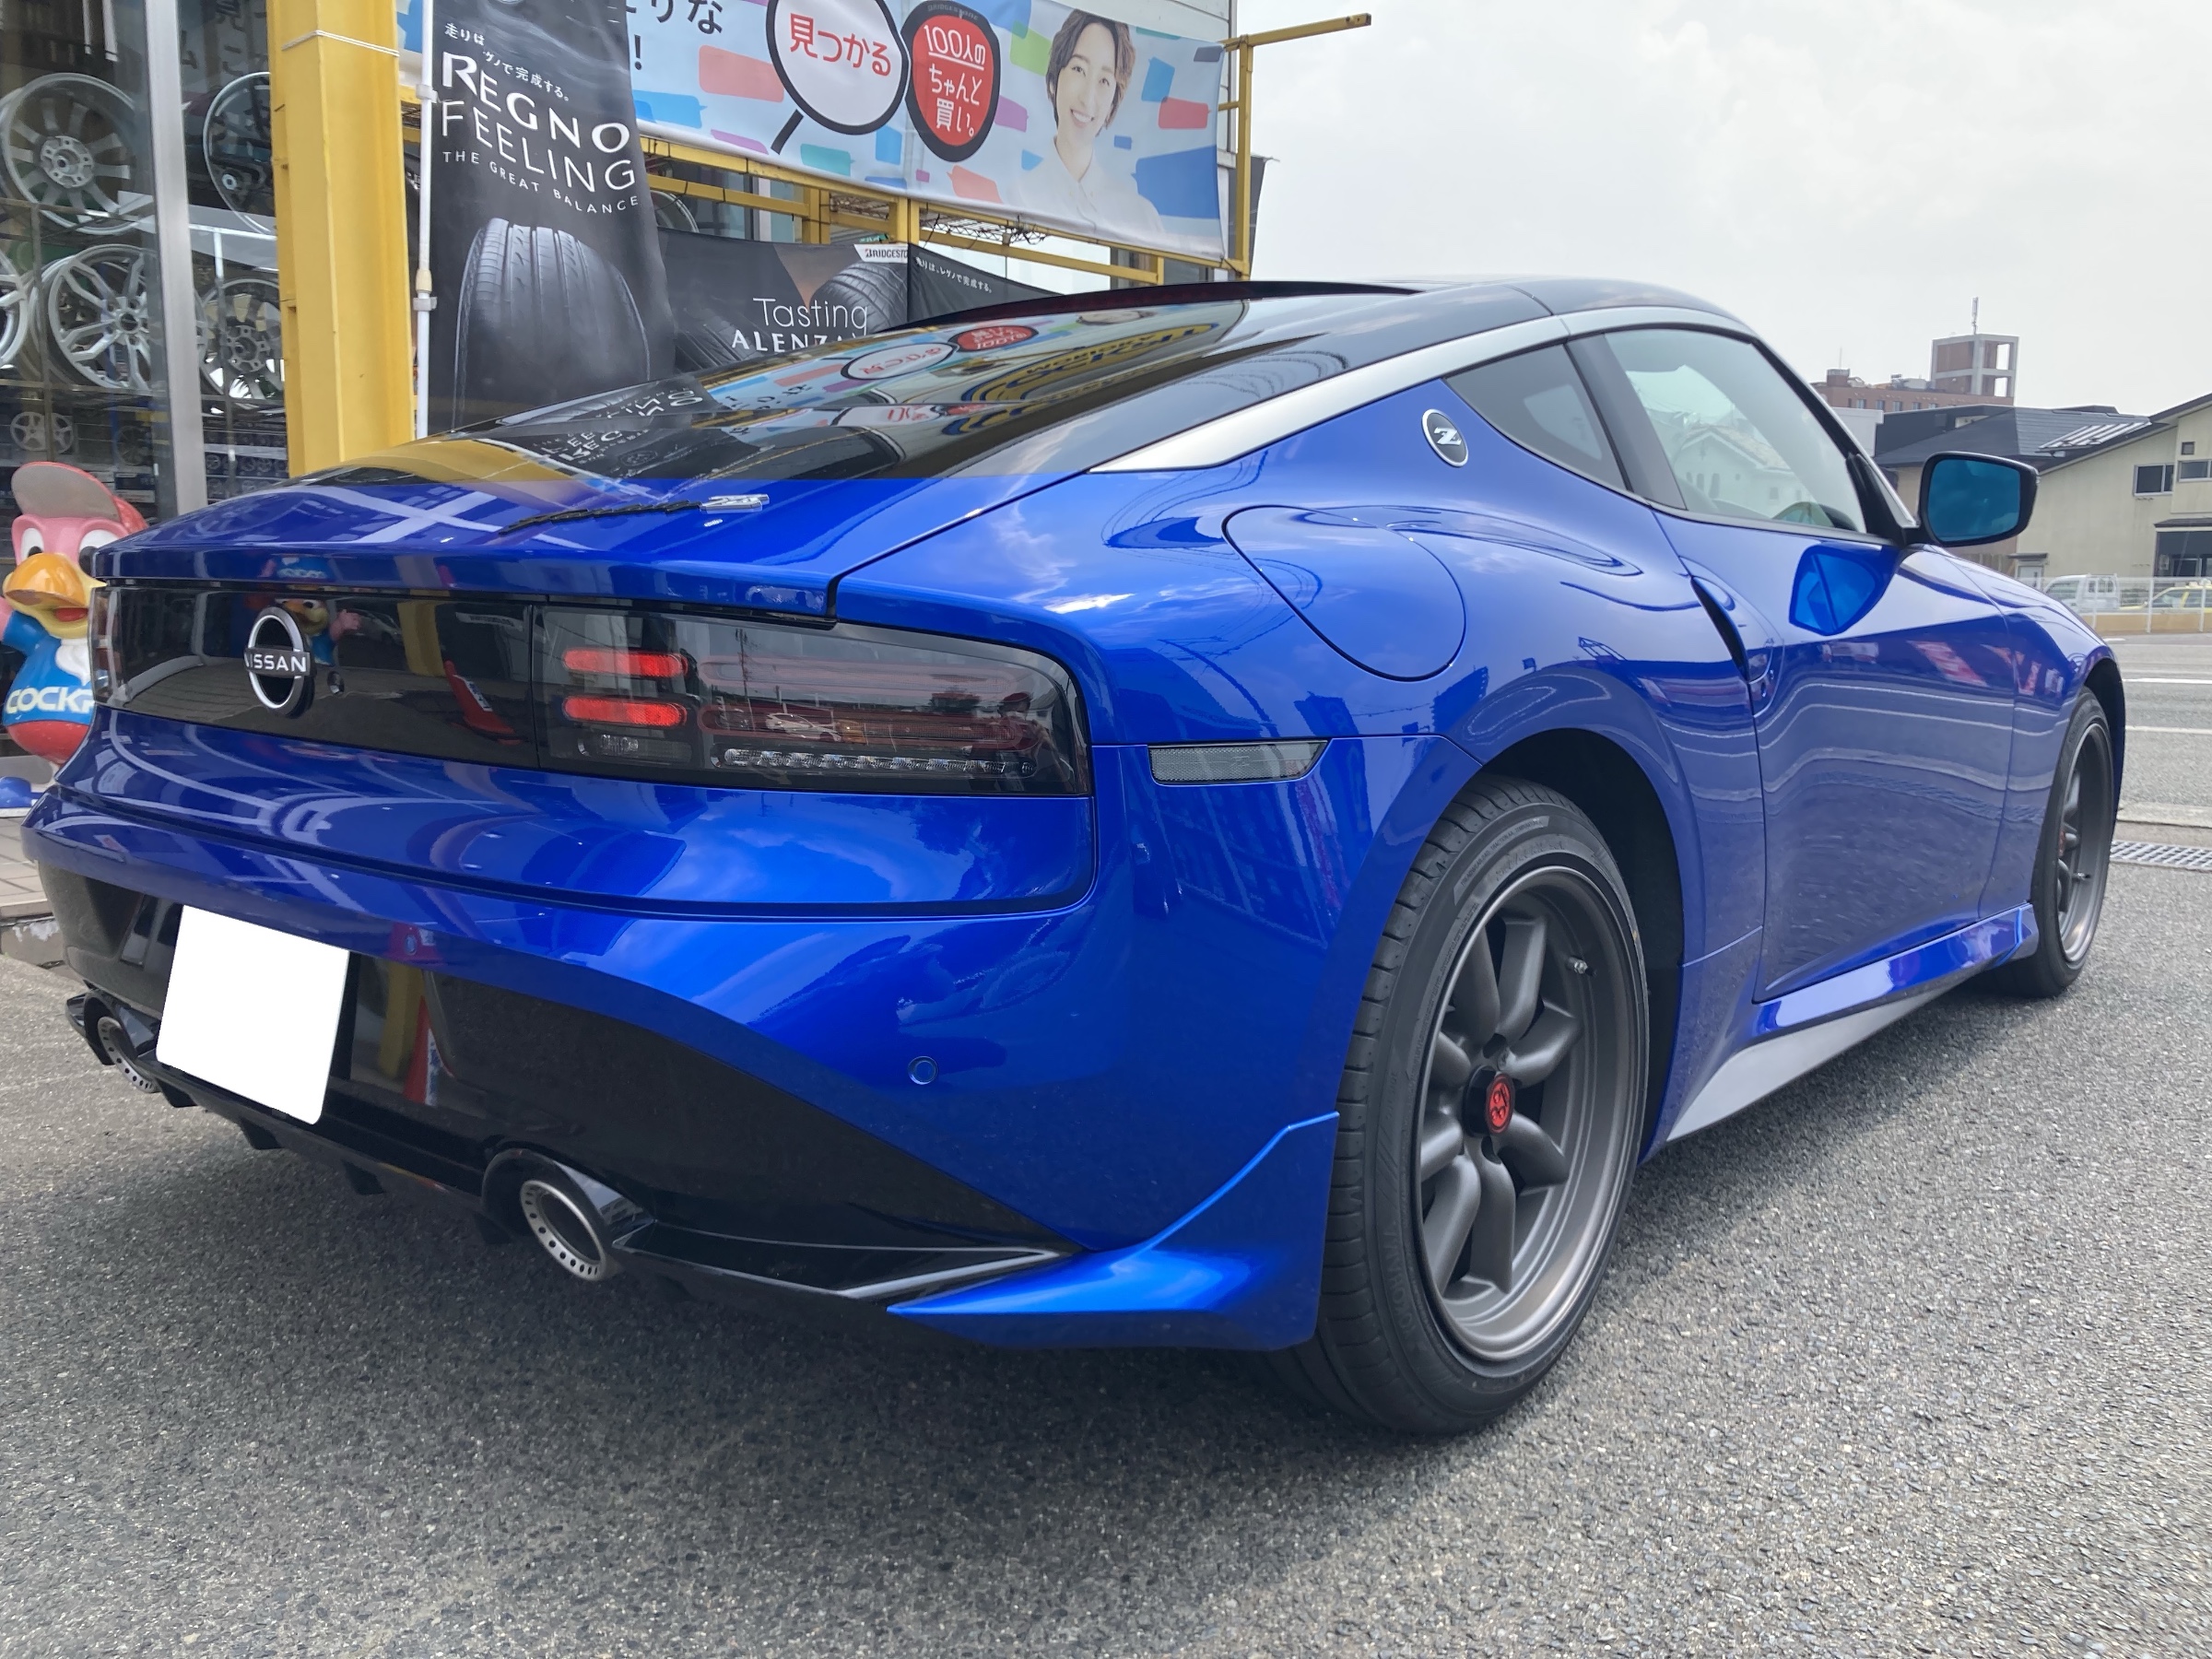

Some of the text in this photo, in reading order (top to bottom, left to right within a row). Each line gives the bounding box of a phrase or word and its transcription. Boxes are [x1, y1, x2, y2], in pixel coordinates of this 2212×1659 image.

[627, 0, 724, 35] りな
[444, 22, 570, 101] 走りはグノで完成する。
[790, 13, 891, 76] 見つかる
[924, 24, 986, 65] 100人の
[442, 51, 630, 153] REGNO
[928, 63, 982, 105] ちゃんと
[936, 97, 974, 137] 買い。
[441, 100, 636, 193] FEELING
[442, 151, 639, 214] THE GREAT BALANCE
[752, 297, 868, 336] Tasting
[732, 329, 843, 353] ALENZ
[1434, 427, 1462, 445] Z
[243, 653, 308, 673] NISSAN
